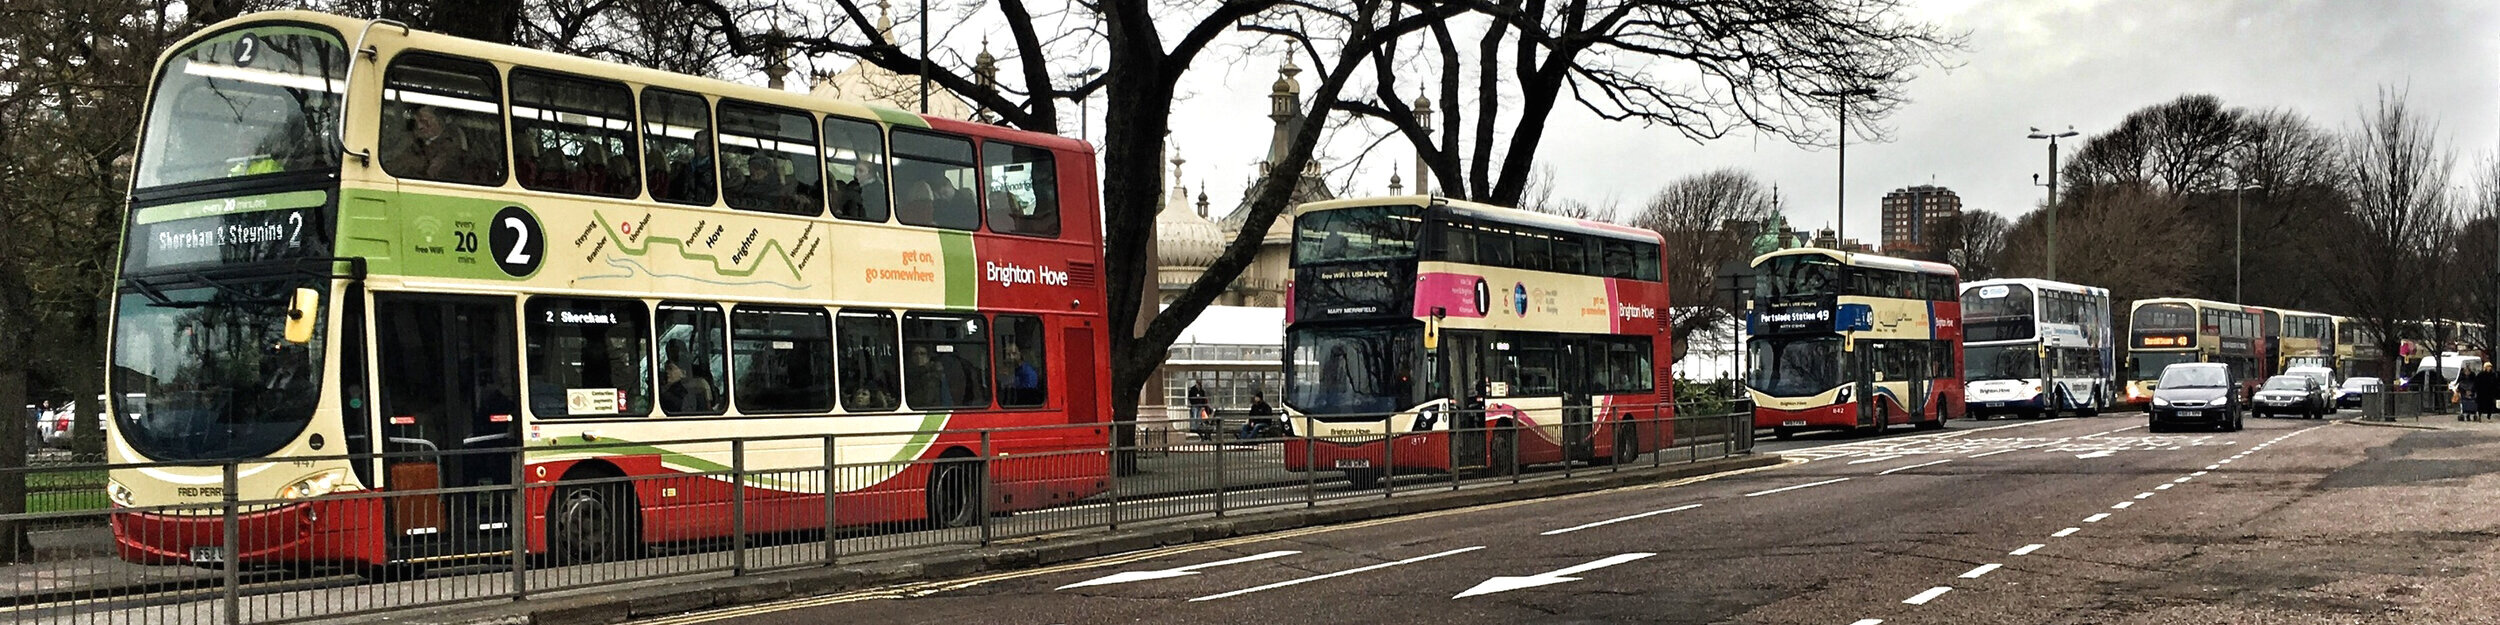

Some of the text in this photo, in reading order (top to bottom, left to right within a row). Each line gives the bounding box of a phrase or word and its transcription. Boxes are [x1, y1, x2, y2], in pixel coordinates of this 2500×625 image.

[239, 37, 253, 62] 2
[224, 198, 236, 212] 20
[159, 211, 303, 250] Shoreham & Steyning 2
[455, 220, 476, 231] every
[575, 220, 597, 248] Steyning
[628, 213, 652, 243] Shoreham
[685, 219, 706, 247] Portslade
[705, 224, 725, 249] Hove
[454, 230, 478, 253] 20
[504, 216, 531, 265] 2
[586, 235, 608, 263] Bramber
[731, 228, 759, 265] Brighton
[457, 256, 476, 264] mins
[902, 250, 934, 265] get on,
[865, 266, 934, 283] go somewhere
[986, 260, 1068, 288] Brighton Hove
[1478, 282, 1485, 313] 1
[546, 311, 554, 322] 2
[561, 311, 609, 324] Shoreham
[1620, 302, 1654, 321] Brighton Hove
[1761, 310, 1829, 322] Portslade Station 49
[178, 487, 198, 497] FRED
